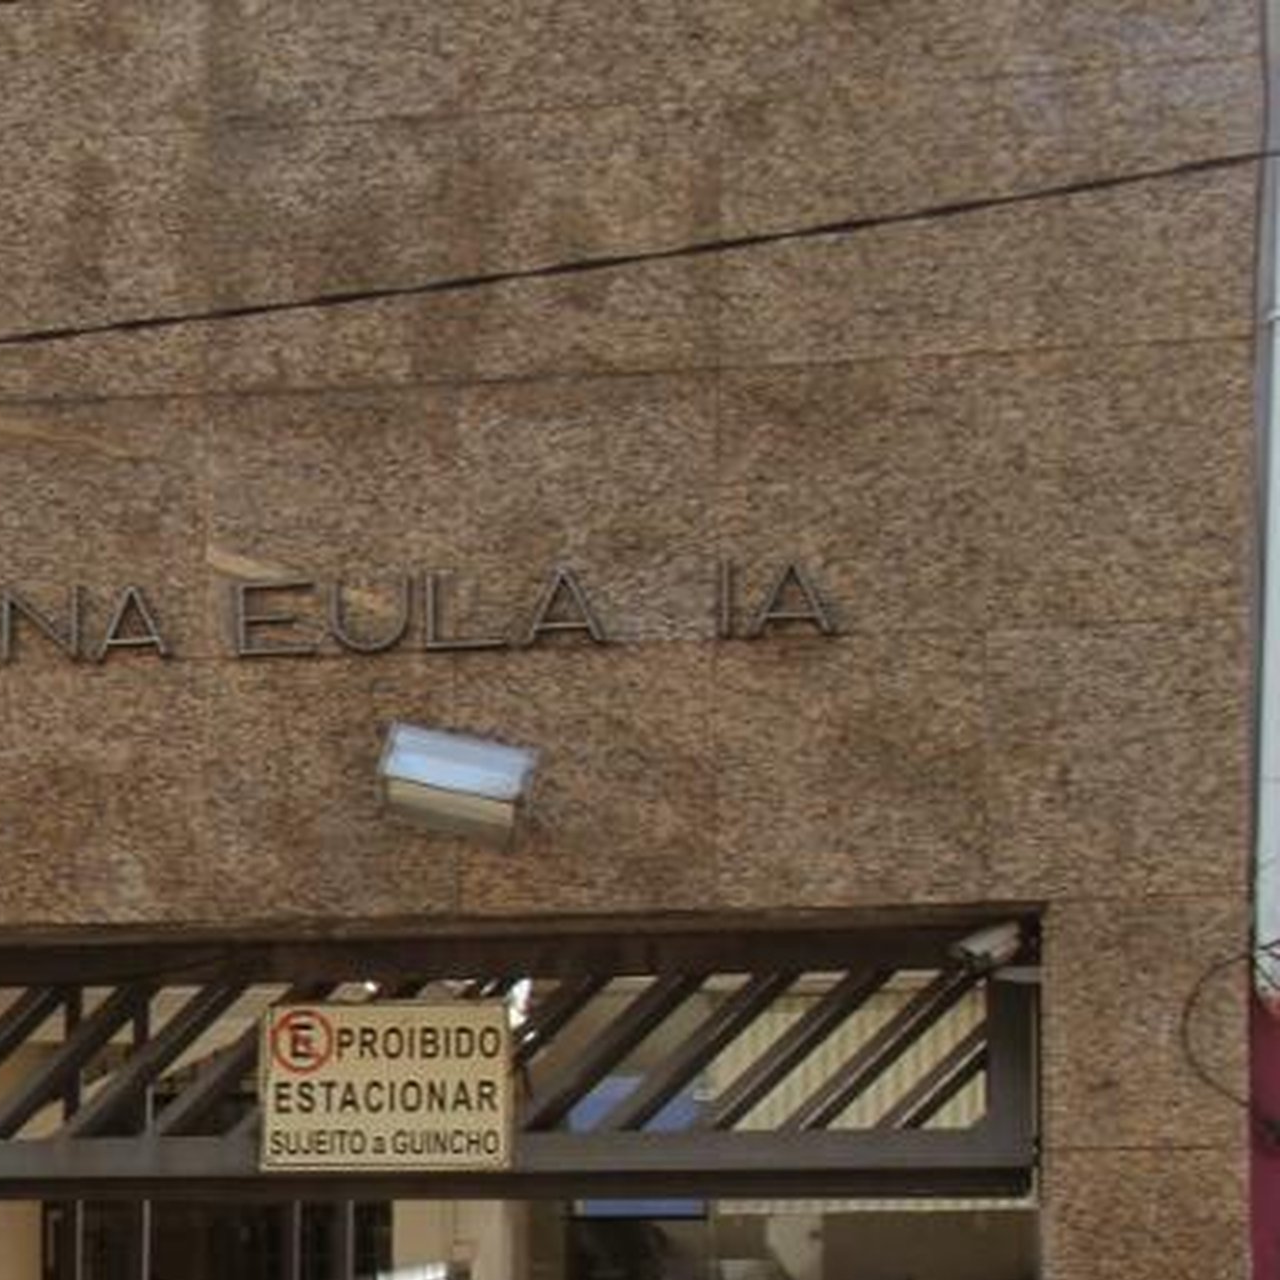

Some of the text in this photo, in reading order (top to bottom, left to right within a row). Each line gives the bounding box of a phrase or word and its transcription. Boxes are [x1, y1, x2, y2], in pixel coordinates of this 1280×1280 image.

[336, 1027, 501, 1059] PROIBIDO
[274, 1080, 499, 1114] ESTACIONAR
[270, 1129, 500, 1155] SUJEITO a GUINCHO
